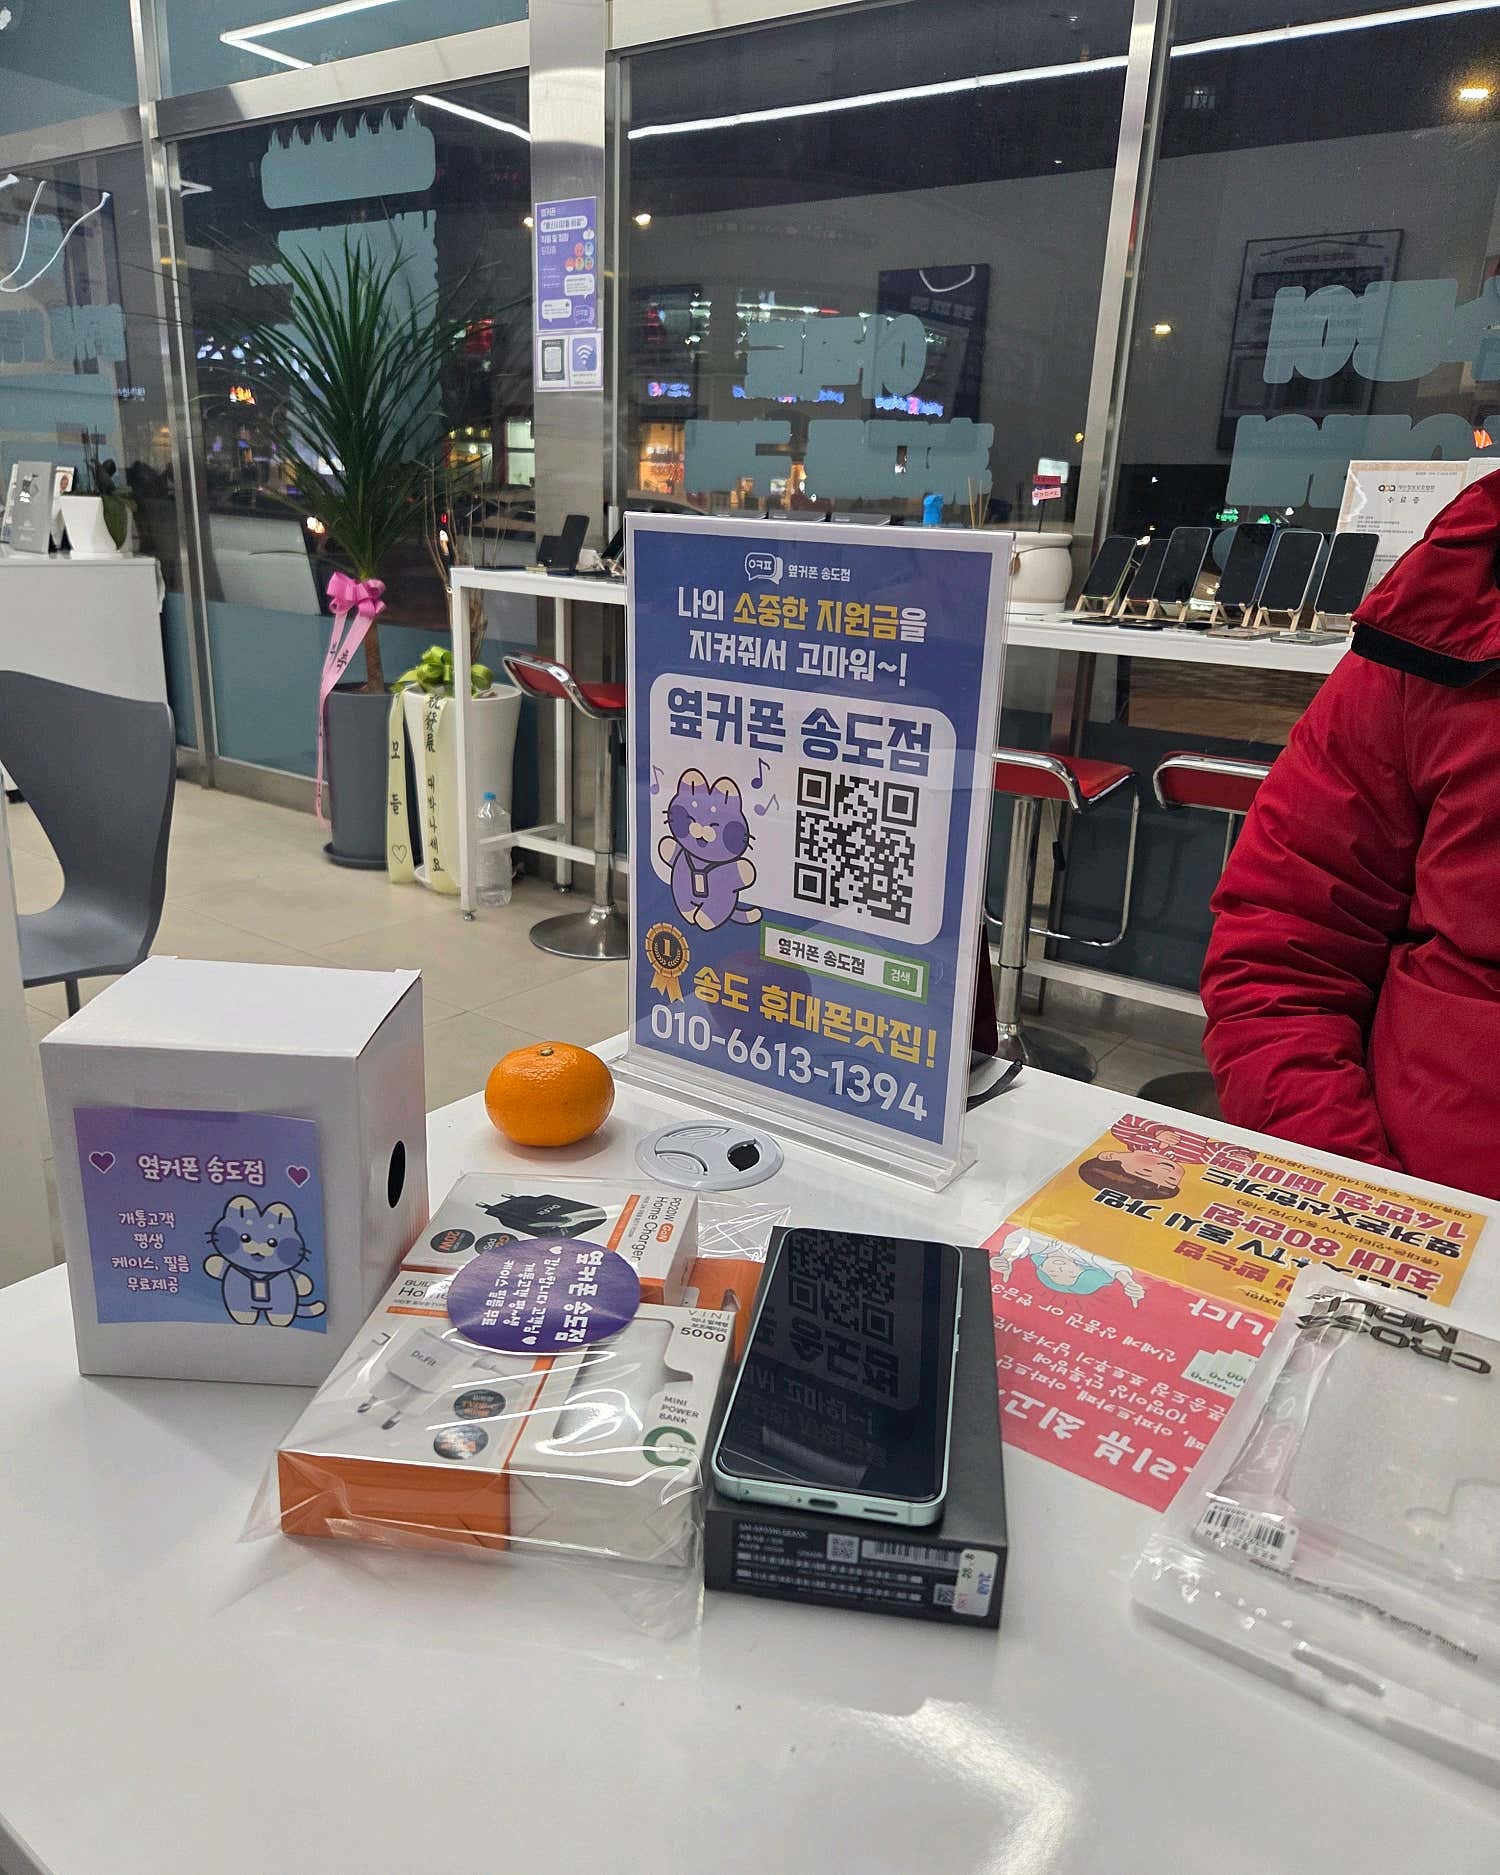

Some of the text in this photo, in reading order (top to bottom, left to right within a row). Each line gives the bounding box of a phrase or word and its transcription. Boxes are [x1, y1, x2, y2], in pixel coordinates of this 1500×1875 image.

[821, 567, 851, 582] 송도점
[677, 586, 928, 643] 나의 소중한 지원금을
[688, 629, 909, 687] 지켜줘서 고마워~!
[667, 687, 933, 777] 옆커폰 송도점
[823, 947, 866, 976] 송도점
[891, 968, 912, 985] 검색
[693, 966, 937, 1069] 송도 휴대폰맛집!
[651, 1003, 928, 1121] 010-6613-1394
[138, 1155, 265, 1186] 옆커폰 송도점
[648, 1196, 668, 1220] Home
[1094, 1188, 1162, 1220] 가입
[1201, 1167, 1462, 1259] 옆커폰X신한카드
[1209, 1152, 1467, 1239] 14만원 페이백
[118, 1209, 177, 1229] 개통고객
[1164, 1213, 1235, 1245] 동시
[133, 1232, 164, 1250] 평생
[631, 1221, 658, 1260] Charger
[1202, 1201, 1442, 1291] 최대 80만원
[111, 1255, 190, 1273] 케이스, 필름
[1173, 1239, 1270, 1283] 받는법
[127, 1276, 179, 1294] 무료제공
[481, 1260, 514, 1326] 케이스 필름 무료
[512, 1262, 537, 1298] 개통고객
[523, 1256, 561, 1334] 감사합니다 고객님
[554, 1250, 605, 1343] 옆커폰 송도점
[1038, 1304, 1064, 1316] or
[1065, 1312, 1117, 1339] 상품권
[680, 1327, 726, 1343] 5000
[992, 1315, 1071, 1357] 남겨주시면
[1076, 1352, 1148, 1387] 포토후기
[664, 1396, 688, 1407] MINI
[1032, 1352, 1188, 1425] 10명이상 단톡방에
[659, 1413, 687, 1425] BANK
[661, 1404, 700, 1419] POWER
[998, 1388, 1086, 1440] 최고
[1075, 1385, 1174, 1437] 아파트카페,
